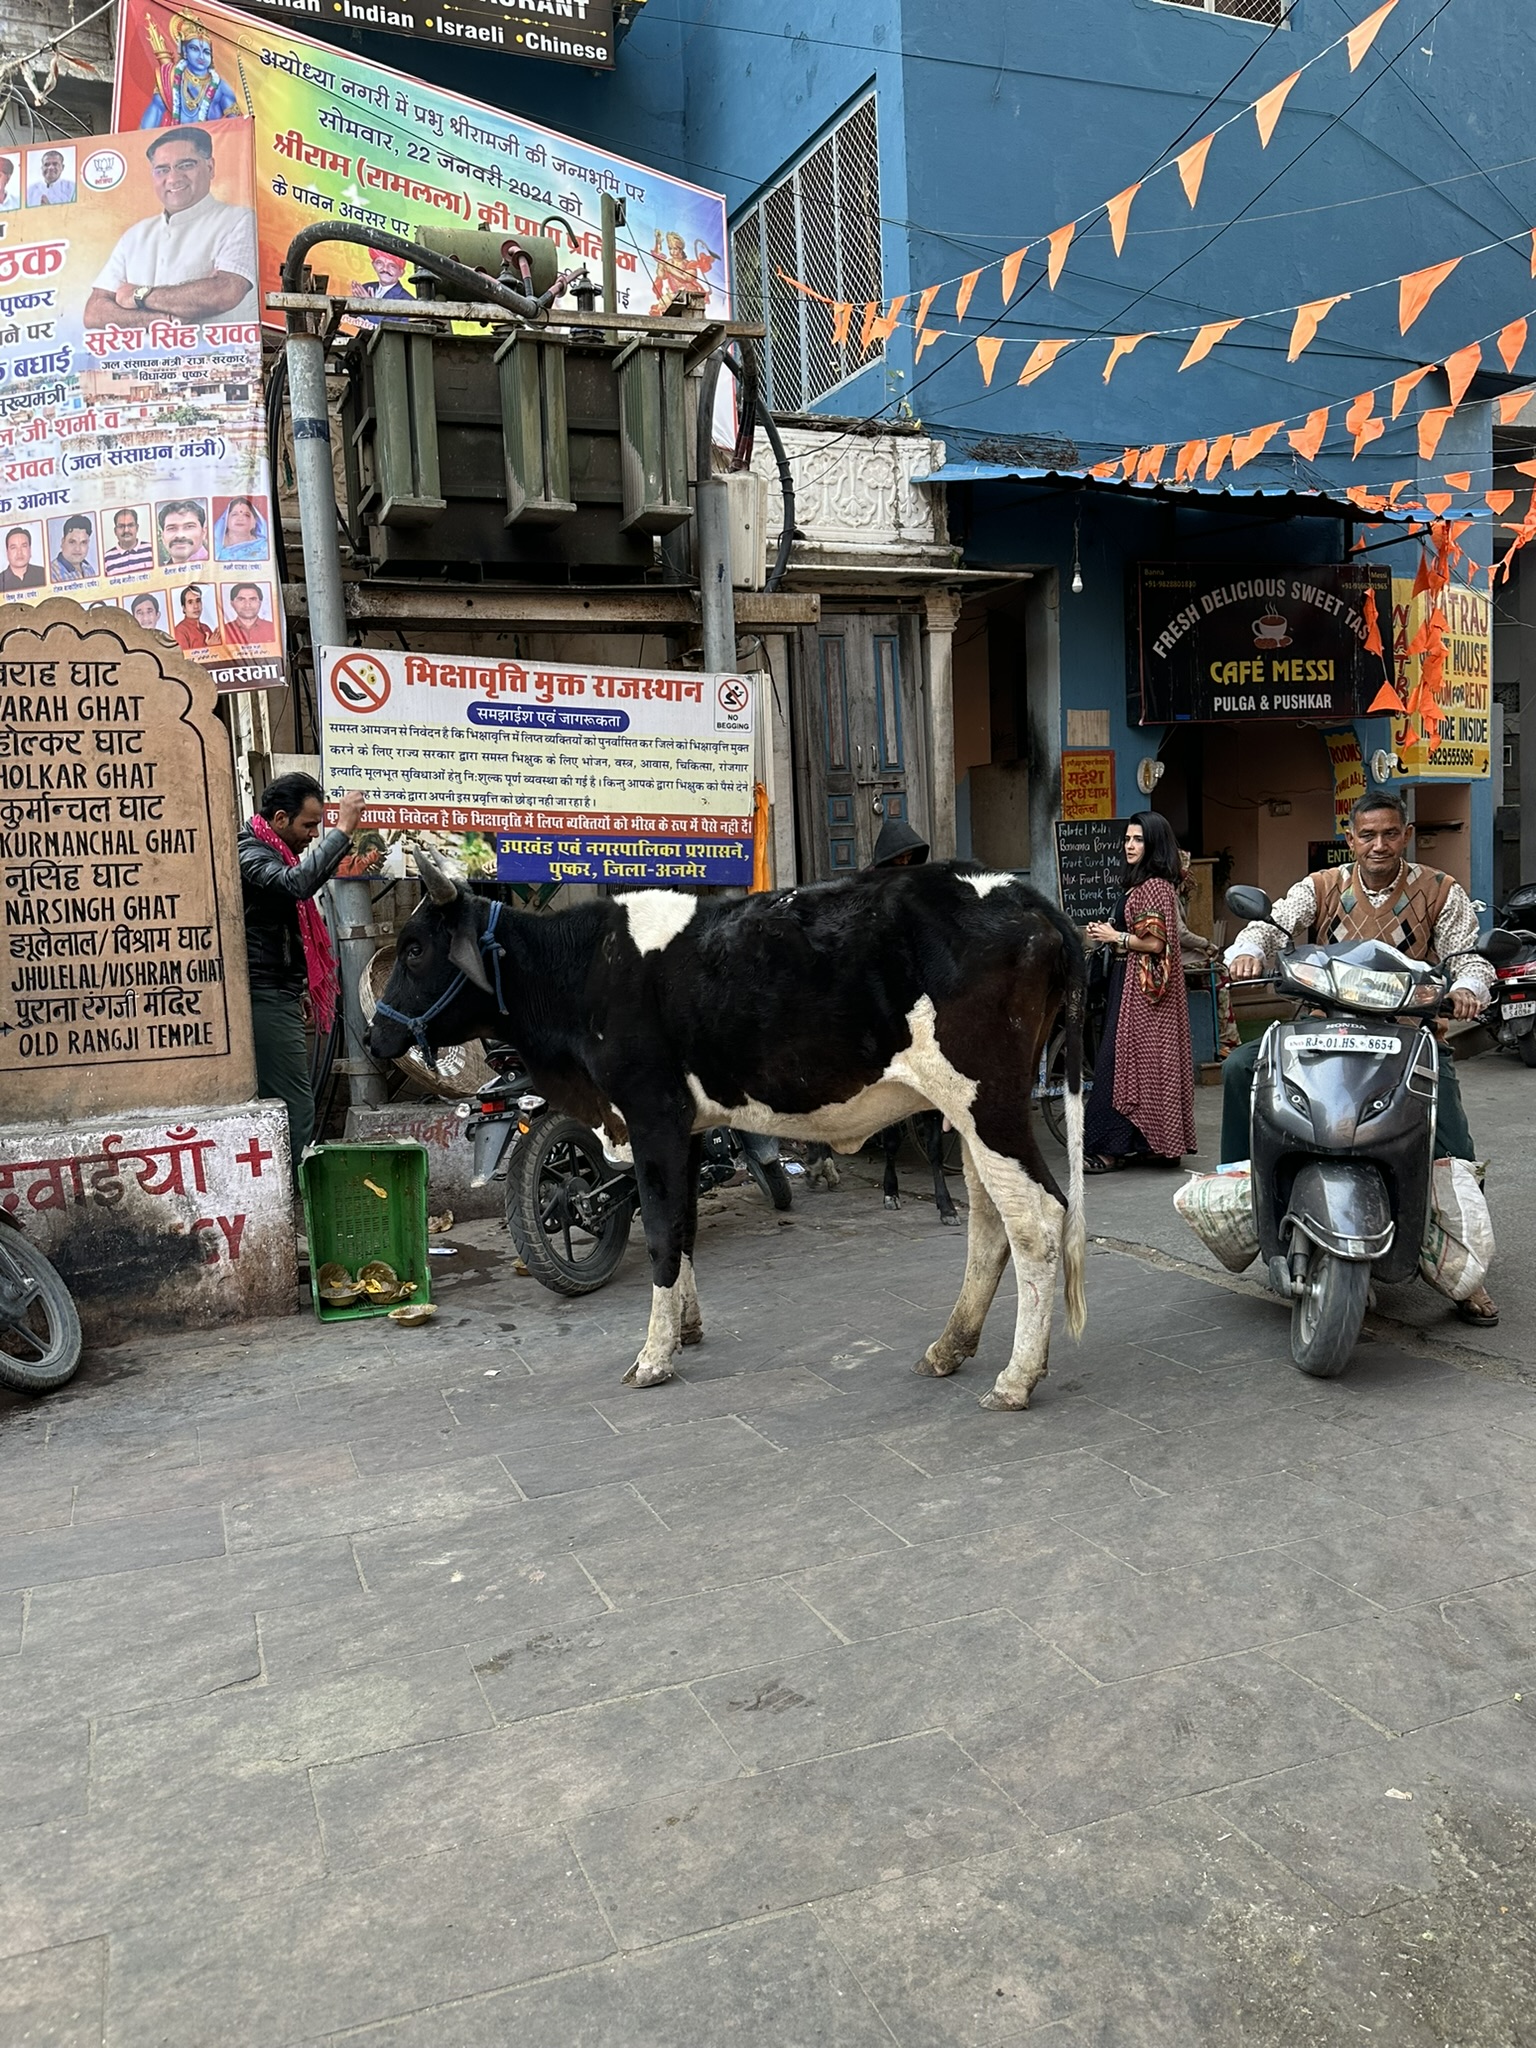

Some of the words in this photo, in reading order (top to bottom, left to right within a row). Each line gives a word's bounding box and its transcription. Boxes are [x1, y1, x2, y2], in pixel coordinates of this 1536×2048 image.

[344, 0, 415, 28] Indian
[437, 16, 505, 44] Israeli
[525, 33, 608, 61] Chinese
[260, 48, 336, 89] अयोध्या
[341, 77, 390, 109] नगरी
[395, 91, 409, 116] में
[413, 104, 445, 136] प्रभु
[450, 115, 520, 157] श्रीरामजी
[525, 144, 547, 167] की
[552, 155, 620, 195] जन्मभूमि
[625, 182, 646, 203] पर
[318, 106, 399, 156] सोमवार,
[407, 142, 430, 163] 22
[437, 151, 502, 189] जनवरी
[509, 178, 552, 206] 2024
[558, 192, 582, 216] को
[272, 174, 287, 197] के
[293, 184, 334, 213] पावन
[339, 201, 388, 229] अवसर
[391, 216, 410, 237] पर
[273, 130, 352, 178] श्रीराम
[356, 156, 473, 221] (रामलला)
[477, 200, 511, 231] की
[566, 231, 637, 273] प्रतिठा
[27, 321, 55, 341] पर
[85, 325, 144, 356] सुरेश
[151, 322, 197, 349] सिंह
[205, 323, 260, 347] रावत
[14, 344, 72, 379] बधाई
[101, 360, 121, 370] जल
[139, 370, 177, 382] विधायक
[21, 417, 47, 443] जी
[54, 408, 98, 438] शर्मा
[104, 411, 120, 429] व
[5, 456, 55, 482] रावत
[61, 452, 101, 477] (जल
[107, 444, 173, 466] संसाधन
[179, 437, 226, 460] मंत्री)
[18, 488, 71, 511] आभार
[1152, 603, 1201, 659] FRESH
[1200, 578, 1286, 614] DELICIOUS
[1291, 581, 1344, 616] SWEET
[1344, 607, 1370, 640] TAS
[1210, 655, 1265, 685] CAFÉ
[1272, 659, 1334, 681] MESSI
[1453, 640, 1488, 676] HOUSE
[68, 661, 121, 688] घाट
[207, 663, 279, 684] ानसभा
[404, 655, 530, 699] भिक्षावृत्ति
[534, 671, 587, 703] मुक्त
[592, 675, 705, 703] राजस्थान
[0, 695, 68, 723] ARAH
[78, 696, 144, 722] GHAT
[1214, 695, 1256, 712] PULGA
[1260, 694, 1270, 710] &
[1273, 694, 1332, 709] PUSHKAR
[1465, 682, 1488, 709] RENT
[476, 706, 533, 725] समझाईश
[538, 708, 557, 728] एवं
[559, 711, 622, 728] जागरूकता
[716, 722, 750, 731] BEGGING
[727, 714, 739, 722] NO
[1459, 717, 1488, 742] INSIDE
[93, 730, 145, 755] घाट
[329, 723, 358, 734] समस्त
[360, 724, 397, 736] आमजन
[399, 724, 407, 736] से
[409, 724, 440, 739] निवेदन
[442, 726, 449, 739] है
[451, 727, 465, 739] कि
[466, 727, 510, 744] भिक्षावृत्ति
[512, 729, 520, 741] में
[521, 731, 543, 743] लिप्त
[544, 733, 582, 746] व्यक्तियों
[584, 734, 596, 746] को
[639, 739, 653, 750] कर
[655, 737, 674, 750] जिले
[676, 738, 688, 750] को
[731, 743, 749, 755] मुक्त
[1328, 743, 1362, 764] ROOMS
[95, 762, 158, 789] GHAT
[118, 795, 165, 821] घाट
[0, 830, 140, 858] KURMANCHAL
[146, 828, 198, 854] GHAT
[500, 837, 553, 855] उपखंड
[558, 838, 581, 855] एवं
[586, 840, 682, 858] नगरपालिका
[92, 863, 142, 888] घाट
[550, 861, 597, 881] पुष्कर,
[6, 897, 115, 925] NARSINGH
[123, 894, 180, 920] GHAT
[178, 926, 213, 951] घाट
[186, 957, 224, 983] GHAT
[15, 997, 77, 1029] पुराना
[83, 989, 138, 1021] रंगजी
[143, 988, 202, 1017] मंदिर
[1325, 1022, 1367, 1030] HONDA
[19, 1031, 57, 1058] OLD
[68, 1027, 140, 1054] RANGJI
[147, 1022, 214, 1049] TEMPLE
